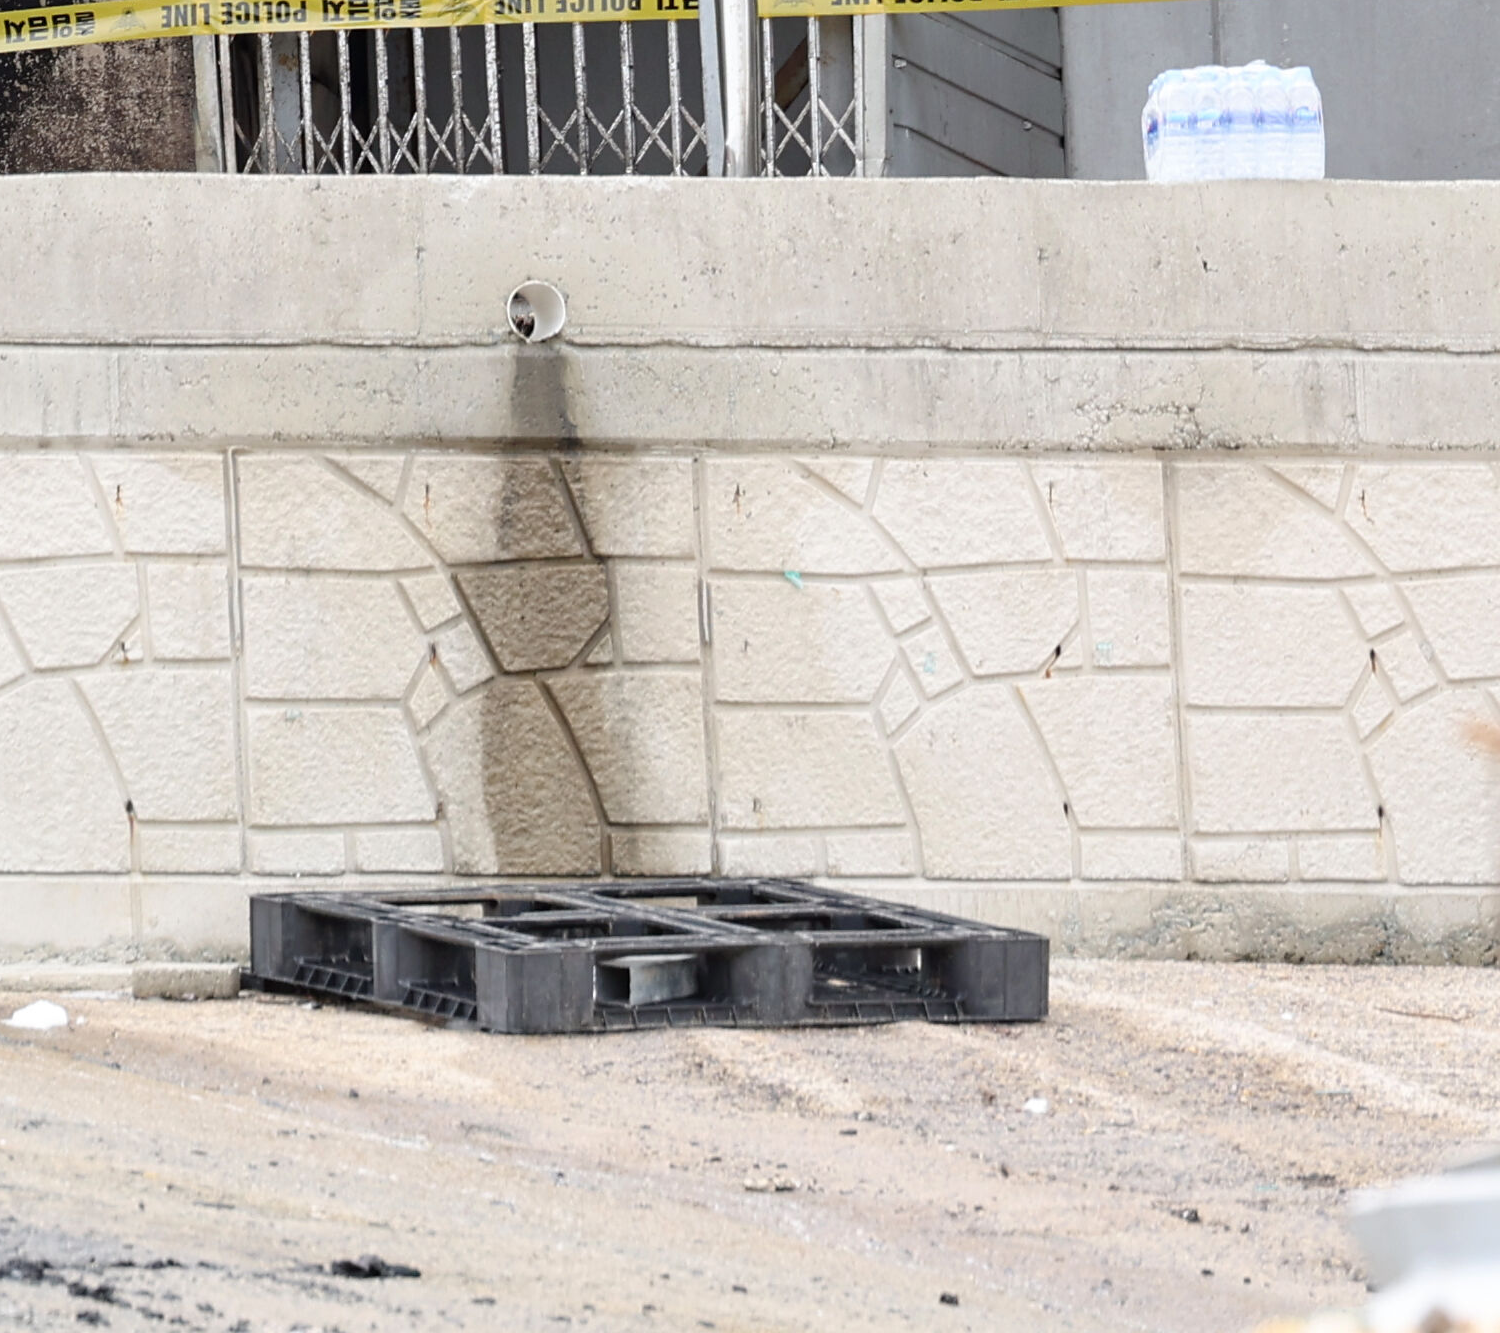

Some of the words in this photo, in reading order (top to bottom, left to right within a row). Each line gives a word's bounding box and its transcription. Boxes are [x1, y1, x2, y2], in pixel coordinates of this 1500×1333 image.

[161, 3, 210, 28] LINE
[221, 0, 307, 25] POLICE
[4, 11, 96, 43] 출입금지
